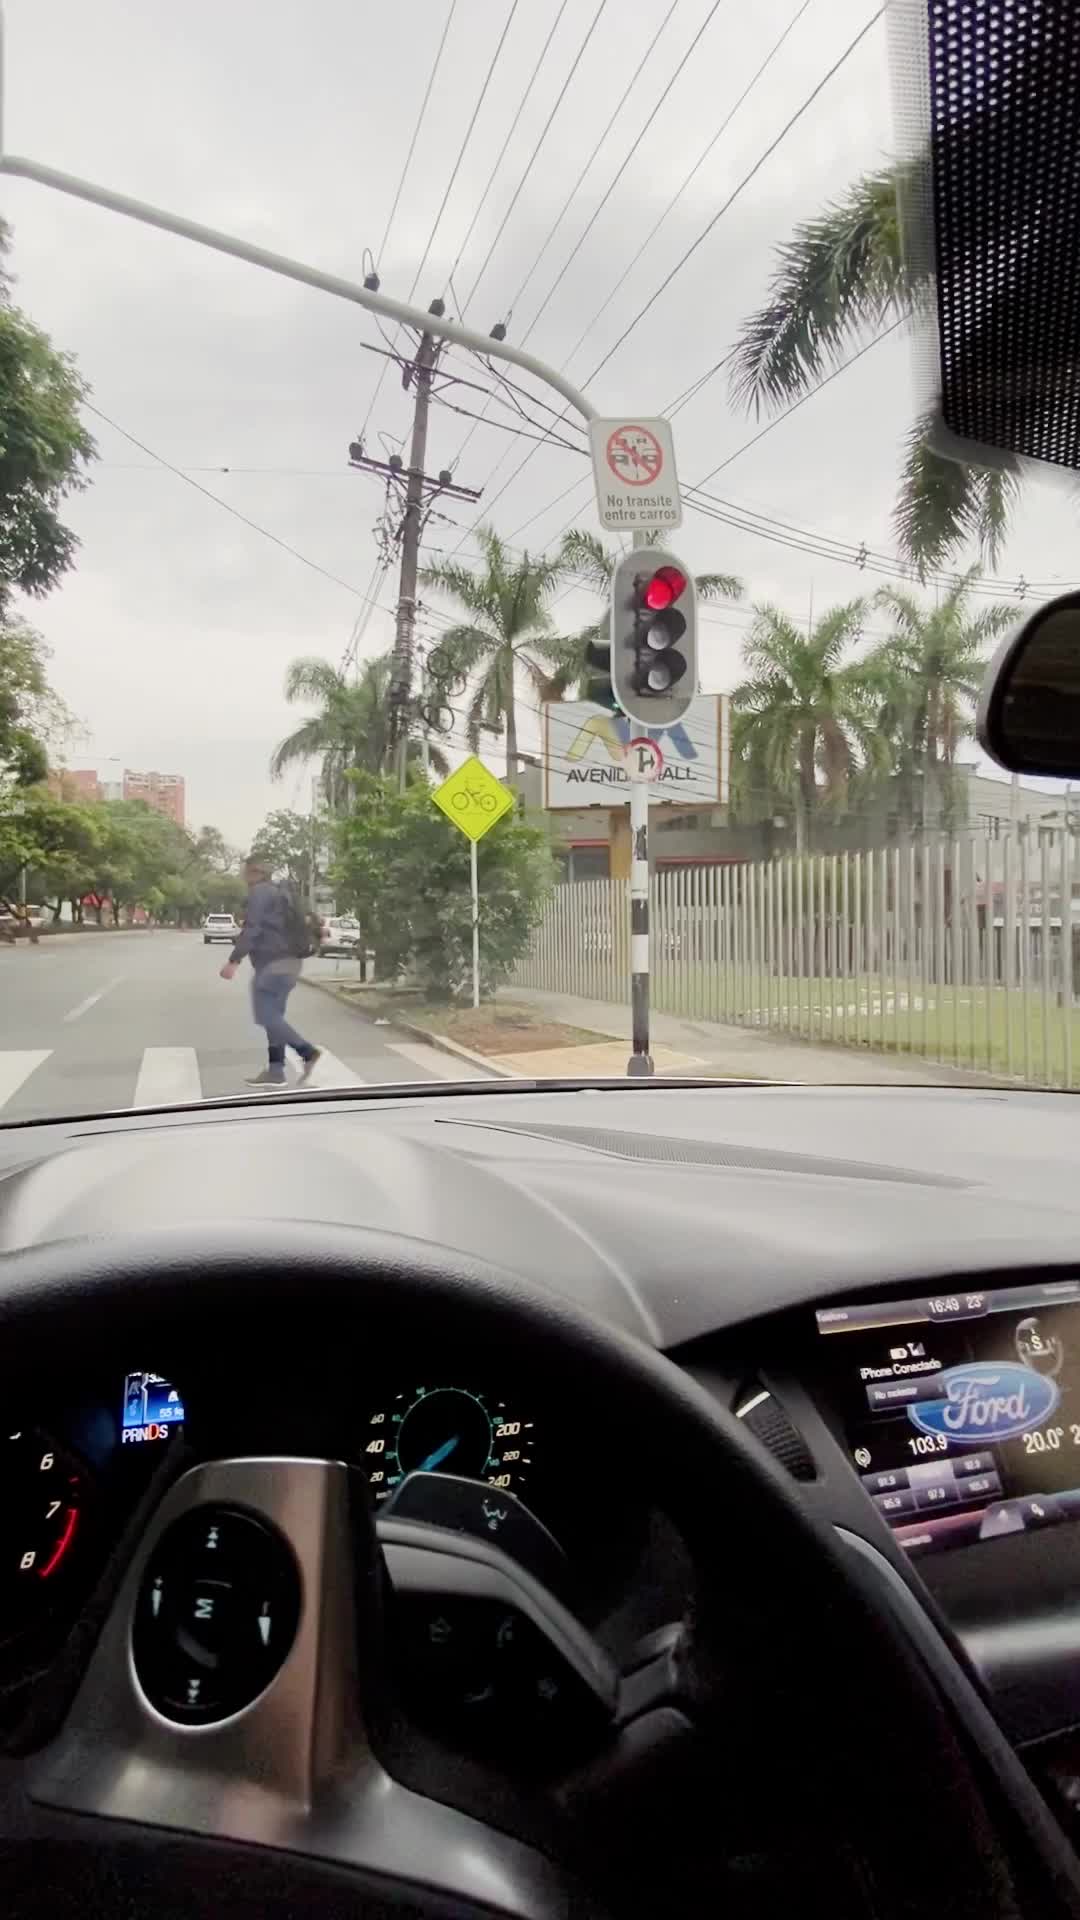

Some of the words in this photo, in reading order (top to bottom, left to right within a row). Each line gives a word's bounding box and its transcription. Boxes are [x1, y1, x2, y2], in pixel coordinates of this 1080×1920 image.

[607, 495, 624, 507] No
[626, 496, 672, 507] transite
[604, 509, 637, 520] entre
[640, 509, 677, 520] carros
[566, 767, 630, 783] AVENID
[928, 1297, 960, 1314] 16:49
[859, 1365, 893, 1380] iPhone
[892, 1357, 943, 1376] Conectado
[942, 1374, 1032, 1430] Ford
[496, 1422, 521, 1437] 200
[366, 1440, 385, 1454] 40
[908, 1433, 948, 1456] 103.9
[40, 1453, 54, 1470] 6
[503, 1450, 520, 1461] 220
[369, 1471, 385, 1483] 20
[46, 1501, 61, 1519] 7
[20, 1552, 36, 1569] 8
